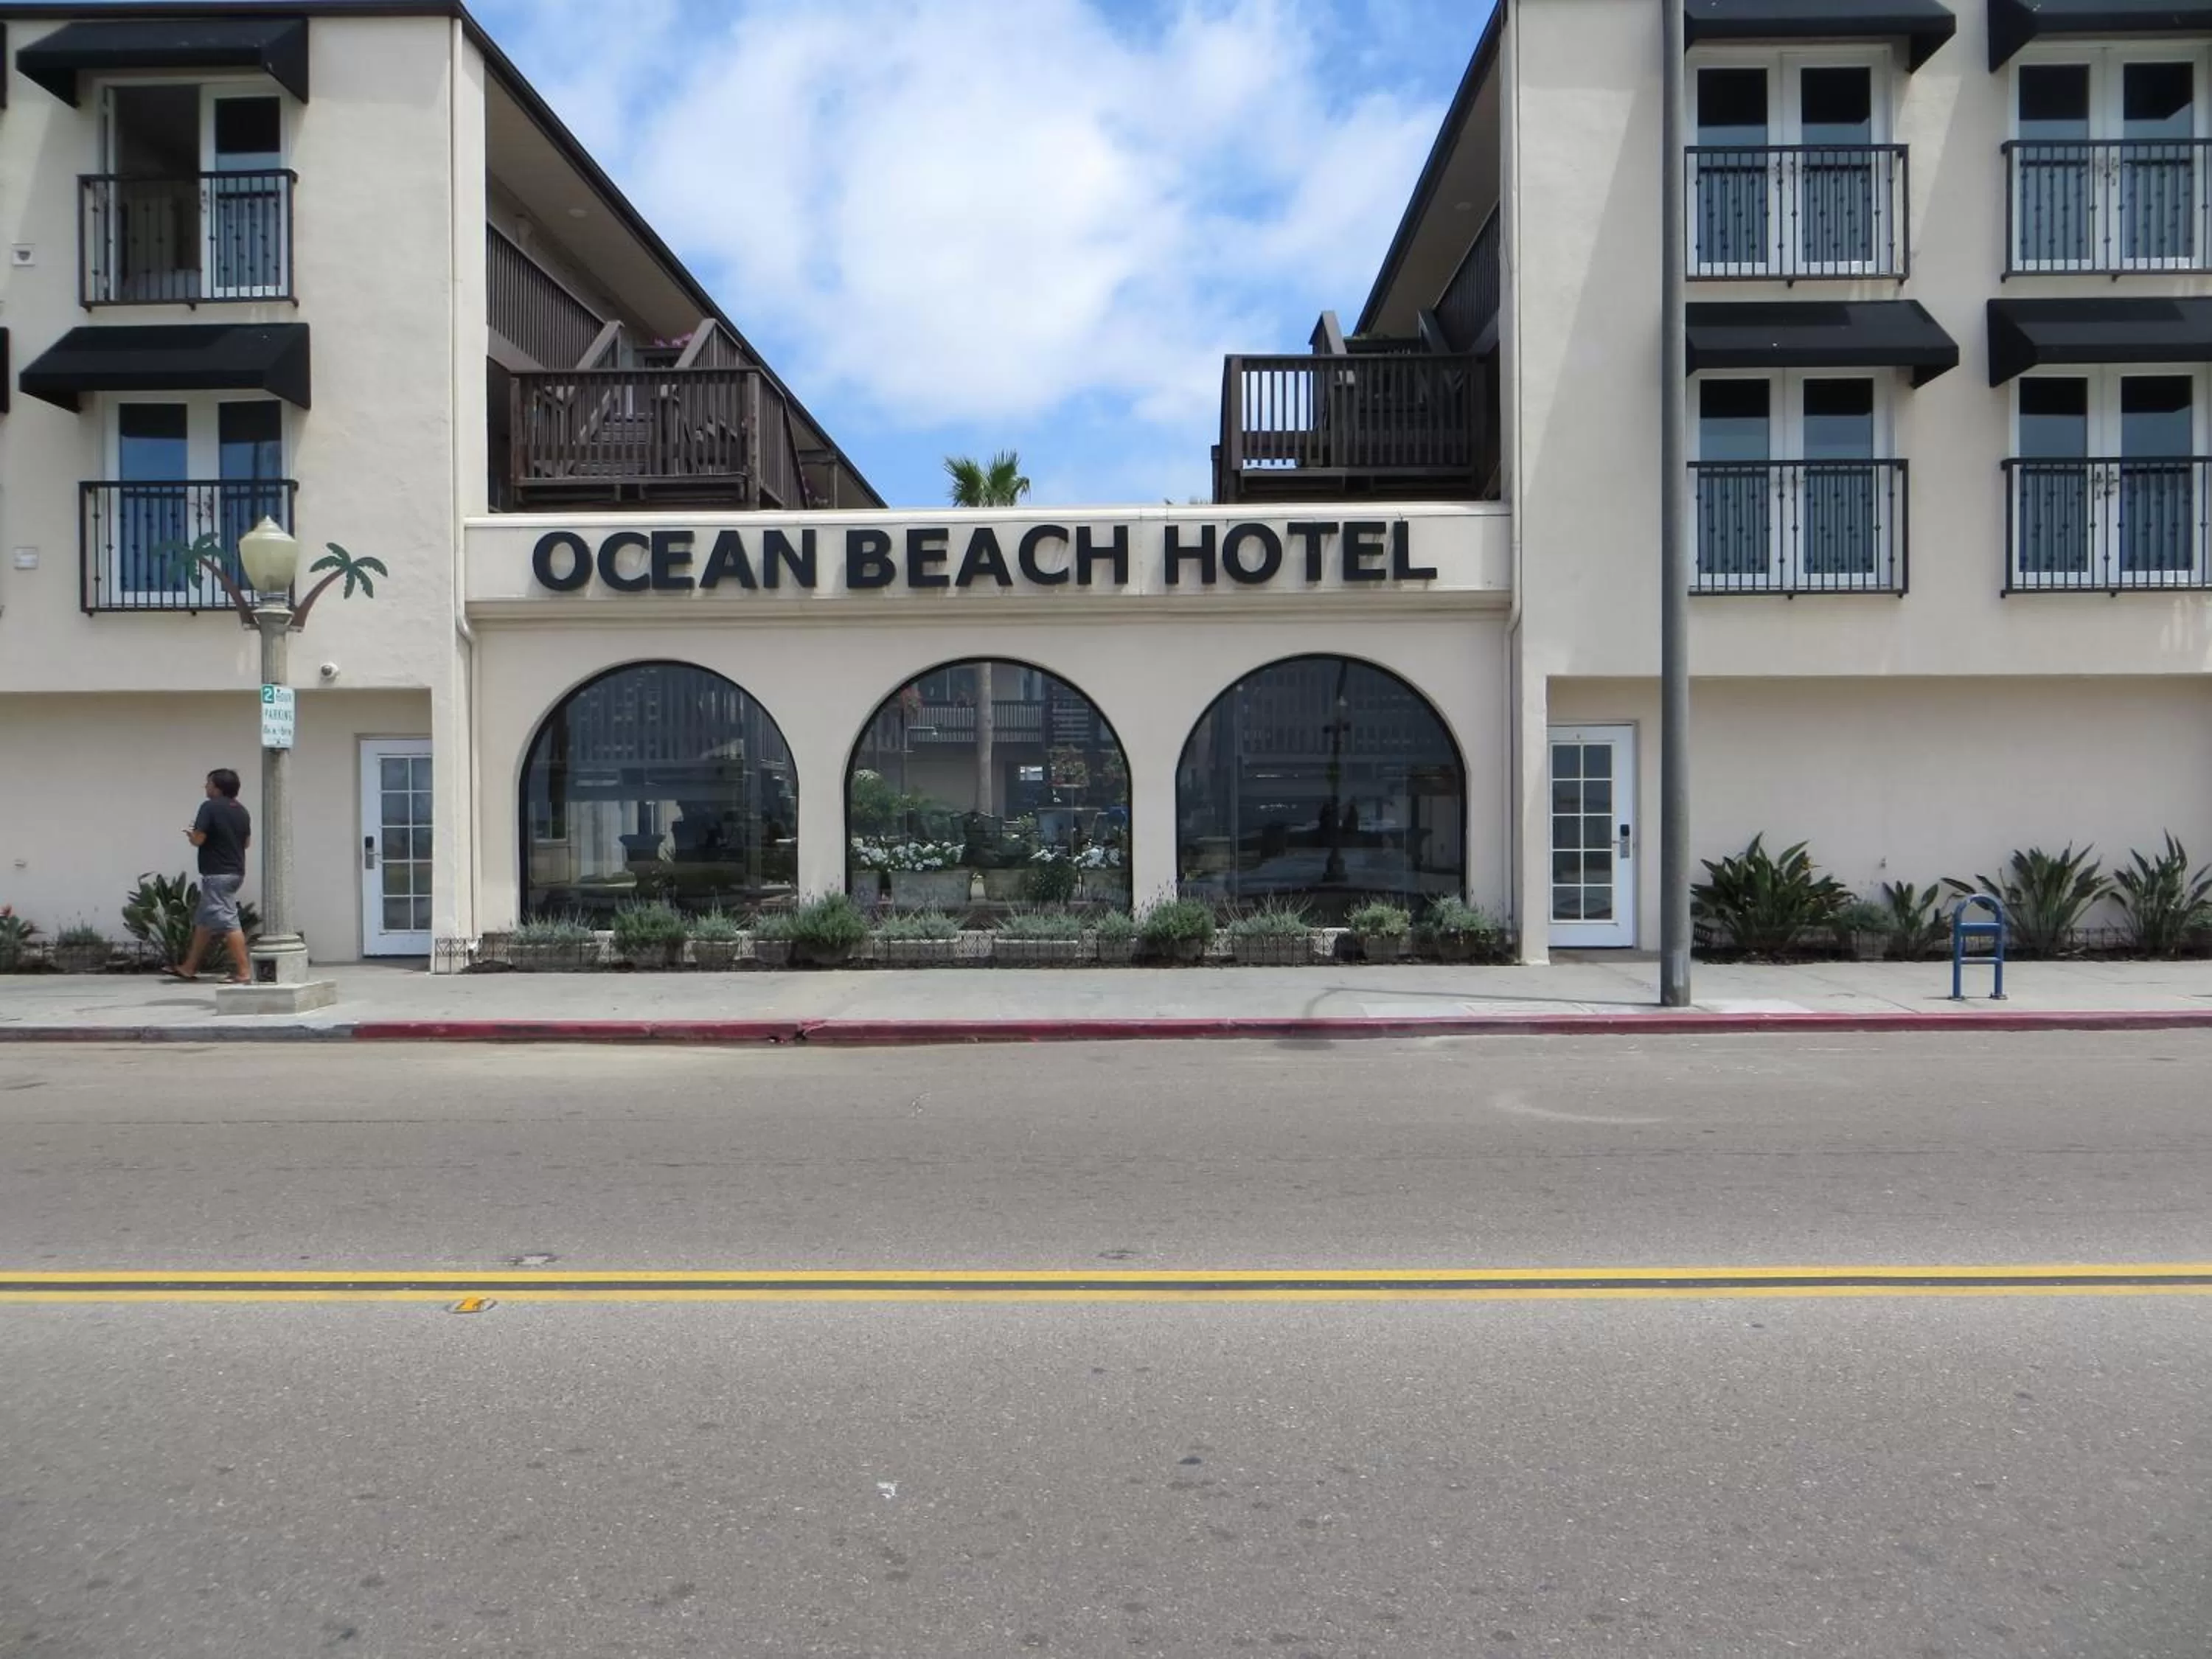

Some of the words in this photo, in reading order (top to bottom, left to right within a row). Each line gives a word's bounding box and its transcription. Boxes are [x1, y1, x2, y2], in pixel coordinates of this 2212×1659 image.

[532, 529, 816, 592] OCEAN
[846, 524, 1129, 590] BEACH
[1164, 521, 1437, 585] HOTEL
[263, 687, 273, 702] 2
